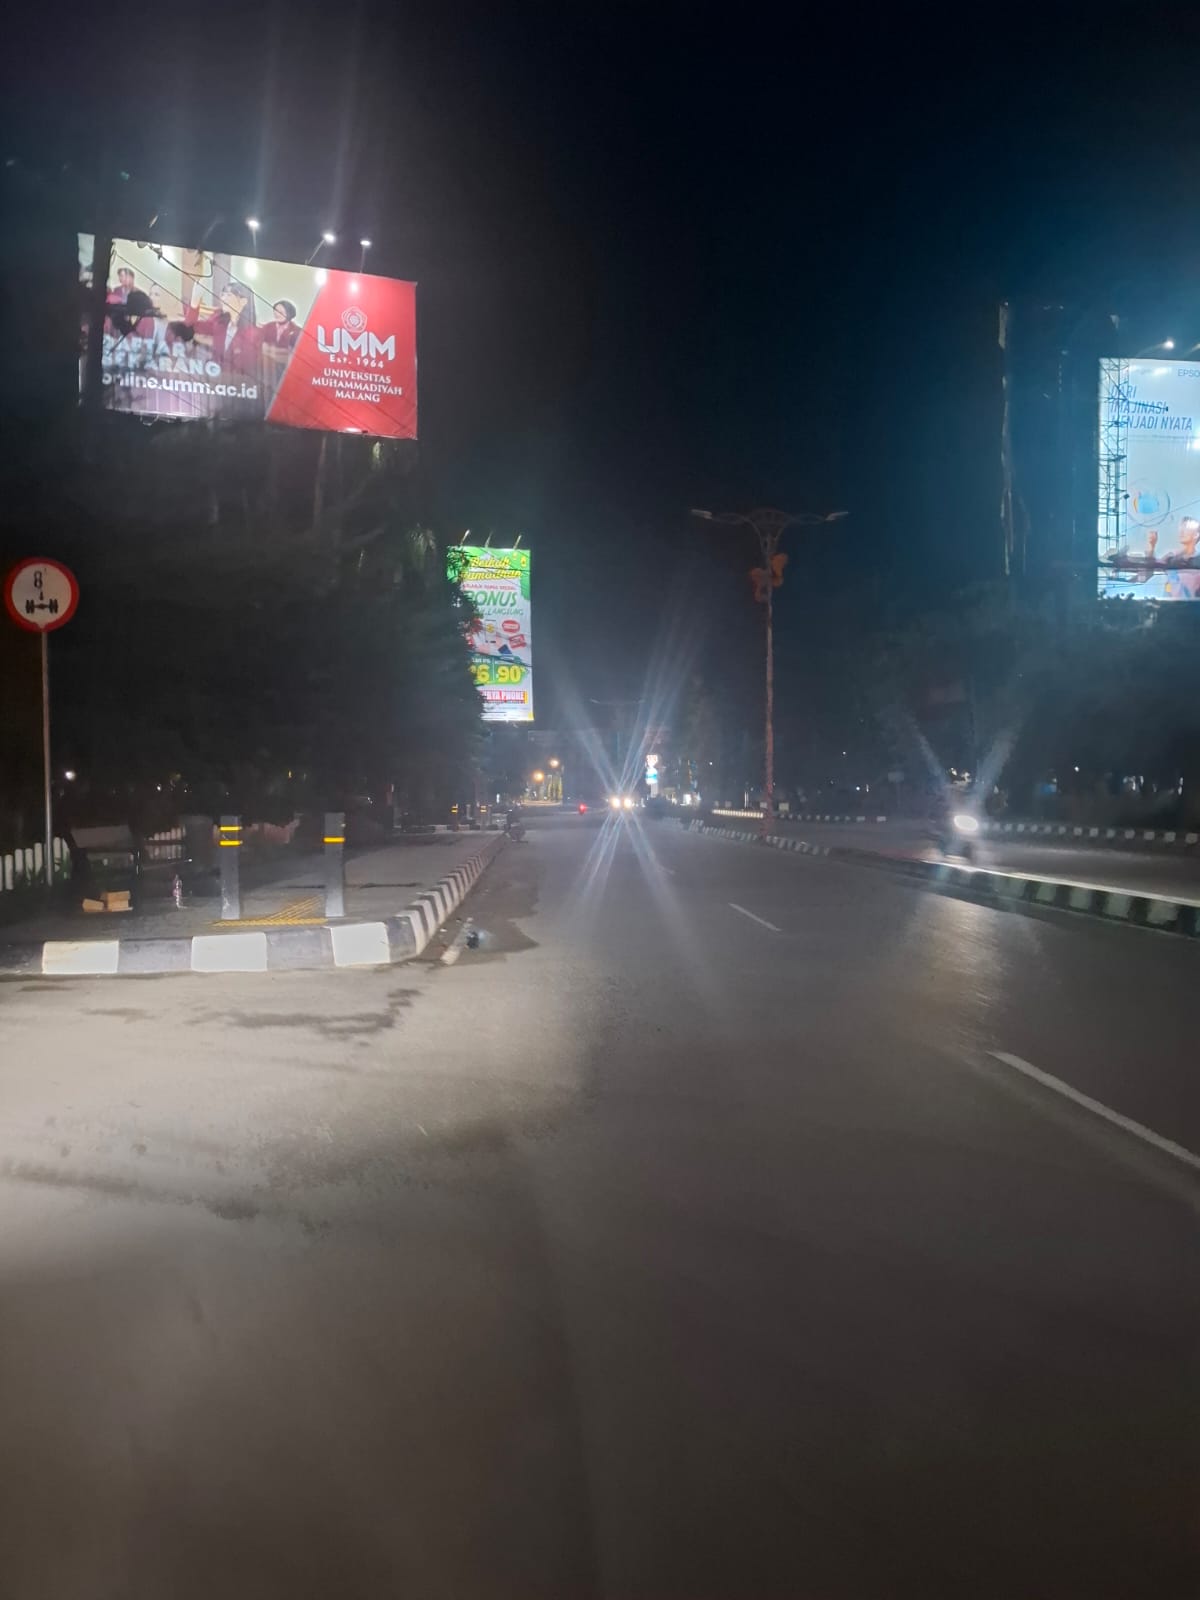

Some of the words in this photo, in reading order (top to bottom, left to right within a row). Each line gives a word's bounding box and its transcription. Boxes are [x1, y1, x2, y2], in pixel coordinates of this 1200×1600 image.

[317, 324, 396, 360] UMM
[356, 357, 384, 368] 1964
[323, 368, 391, 384] UNIVERSITAS
[311, 377, 402, 395] MUHAMMADIYAH
[335, 390, 381, 402] MALANG
[1160, 416, 1193, 430] NYATA
[33, 570, 43, 588] 8
